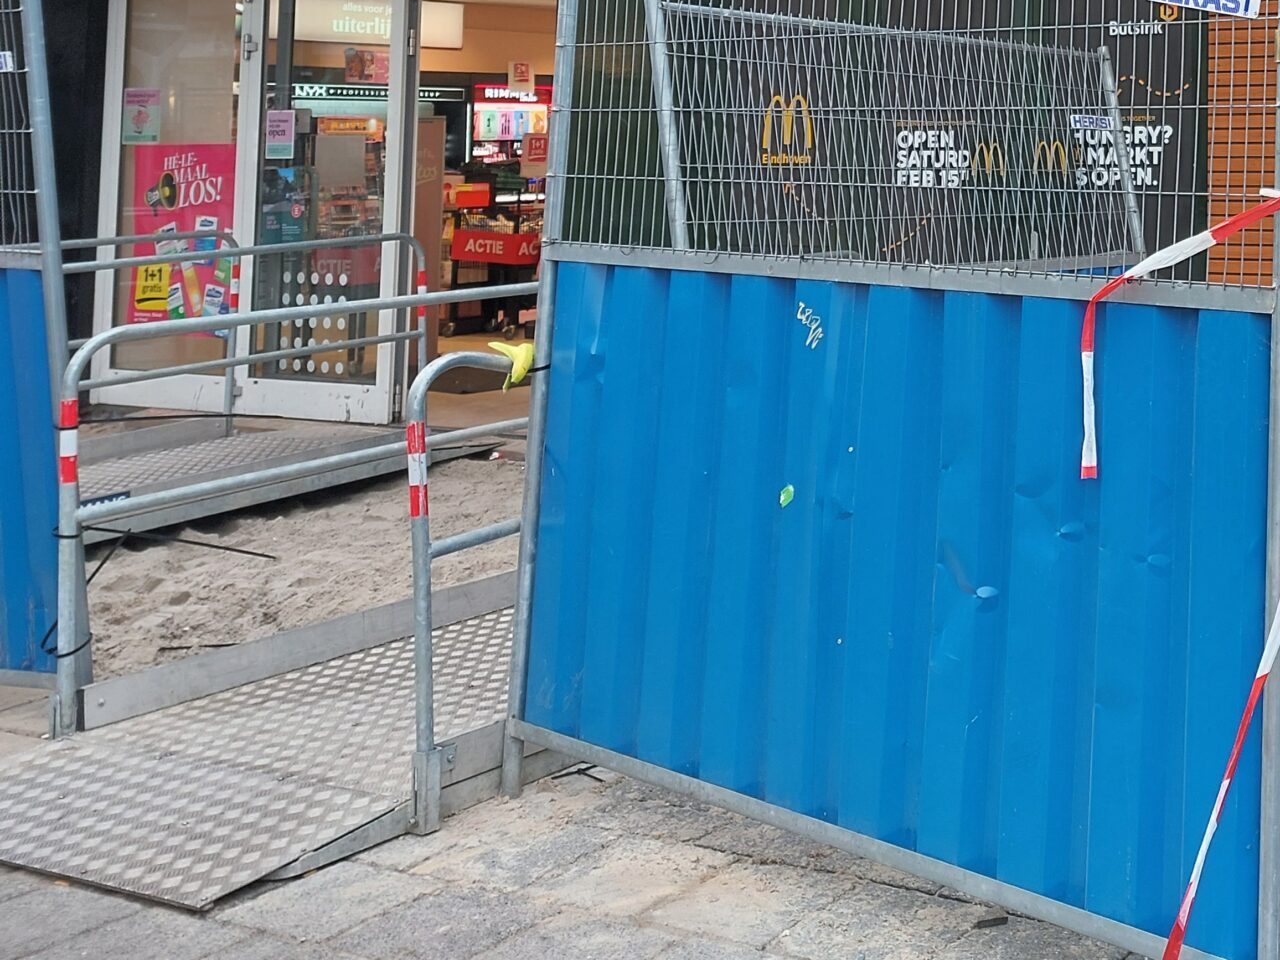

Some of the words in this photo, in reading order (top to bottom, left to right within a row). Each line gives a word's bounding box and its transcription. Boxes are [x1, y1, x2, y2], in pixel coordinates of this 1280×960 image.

[1109, 19, 1163, 36] Butsink
[295, 85, 327, 97] NYX
[897, 130, 955, 149] OPEN
[173, 163, 210, 184] MAAL
[897, 170, 934, 187] FEB
[178, 176, 223, 208] LOS!
[465, 238, 504, 254] ACTIE
[518, 241, 538, 256] AC
[144, 266, 163, 283] 1+1
[142, 283, 162, 295] gratis
